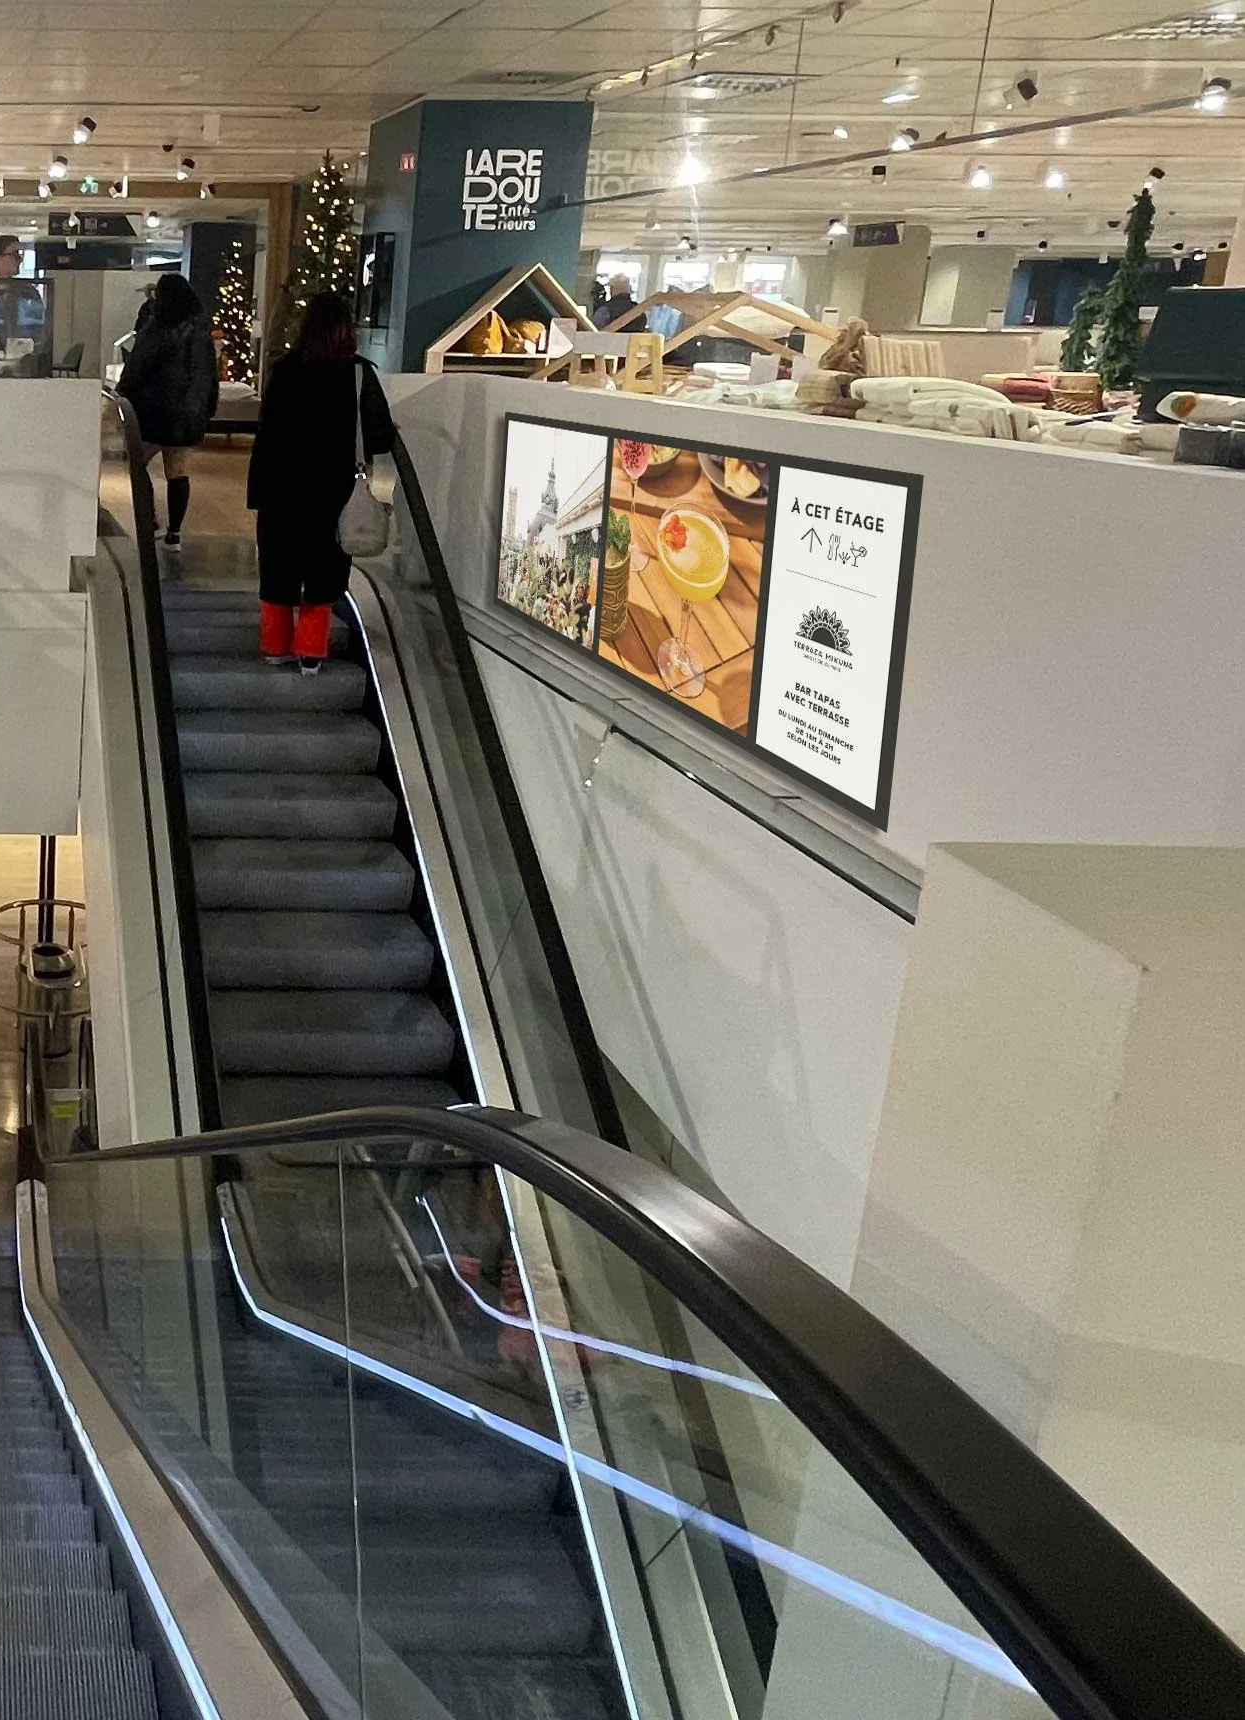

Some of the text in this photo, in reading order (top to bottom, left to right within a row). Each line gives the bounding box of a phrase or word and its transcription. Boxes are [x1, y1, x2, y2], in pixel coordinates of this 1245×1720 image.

[465, 149, 543, 176] LARE
[462, 176, 540, 204] DOU
[462, 204, 498, 231] TE
[791, 497, 884, 533] À CET ÉTAGE
[784, 690, 850, 728] AVEC TERRASSE
[795, 682, 841, 710] BAR TAPAS
[778, 709, 854, 751] DU LUNDI AU DIMANCHE
[795, 727, 804, 736] DE
[787, 732, 841, 765] SELON LES JOURS
